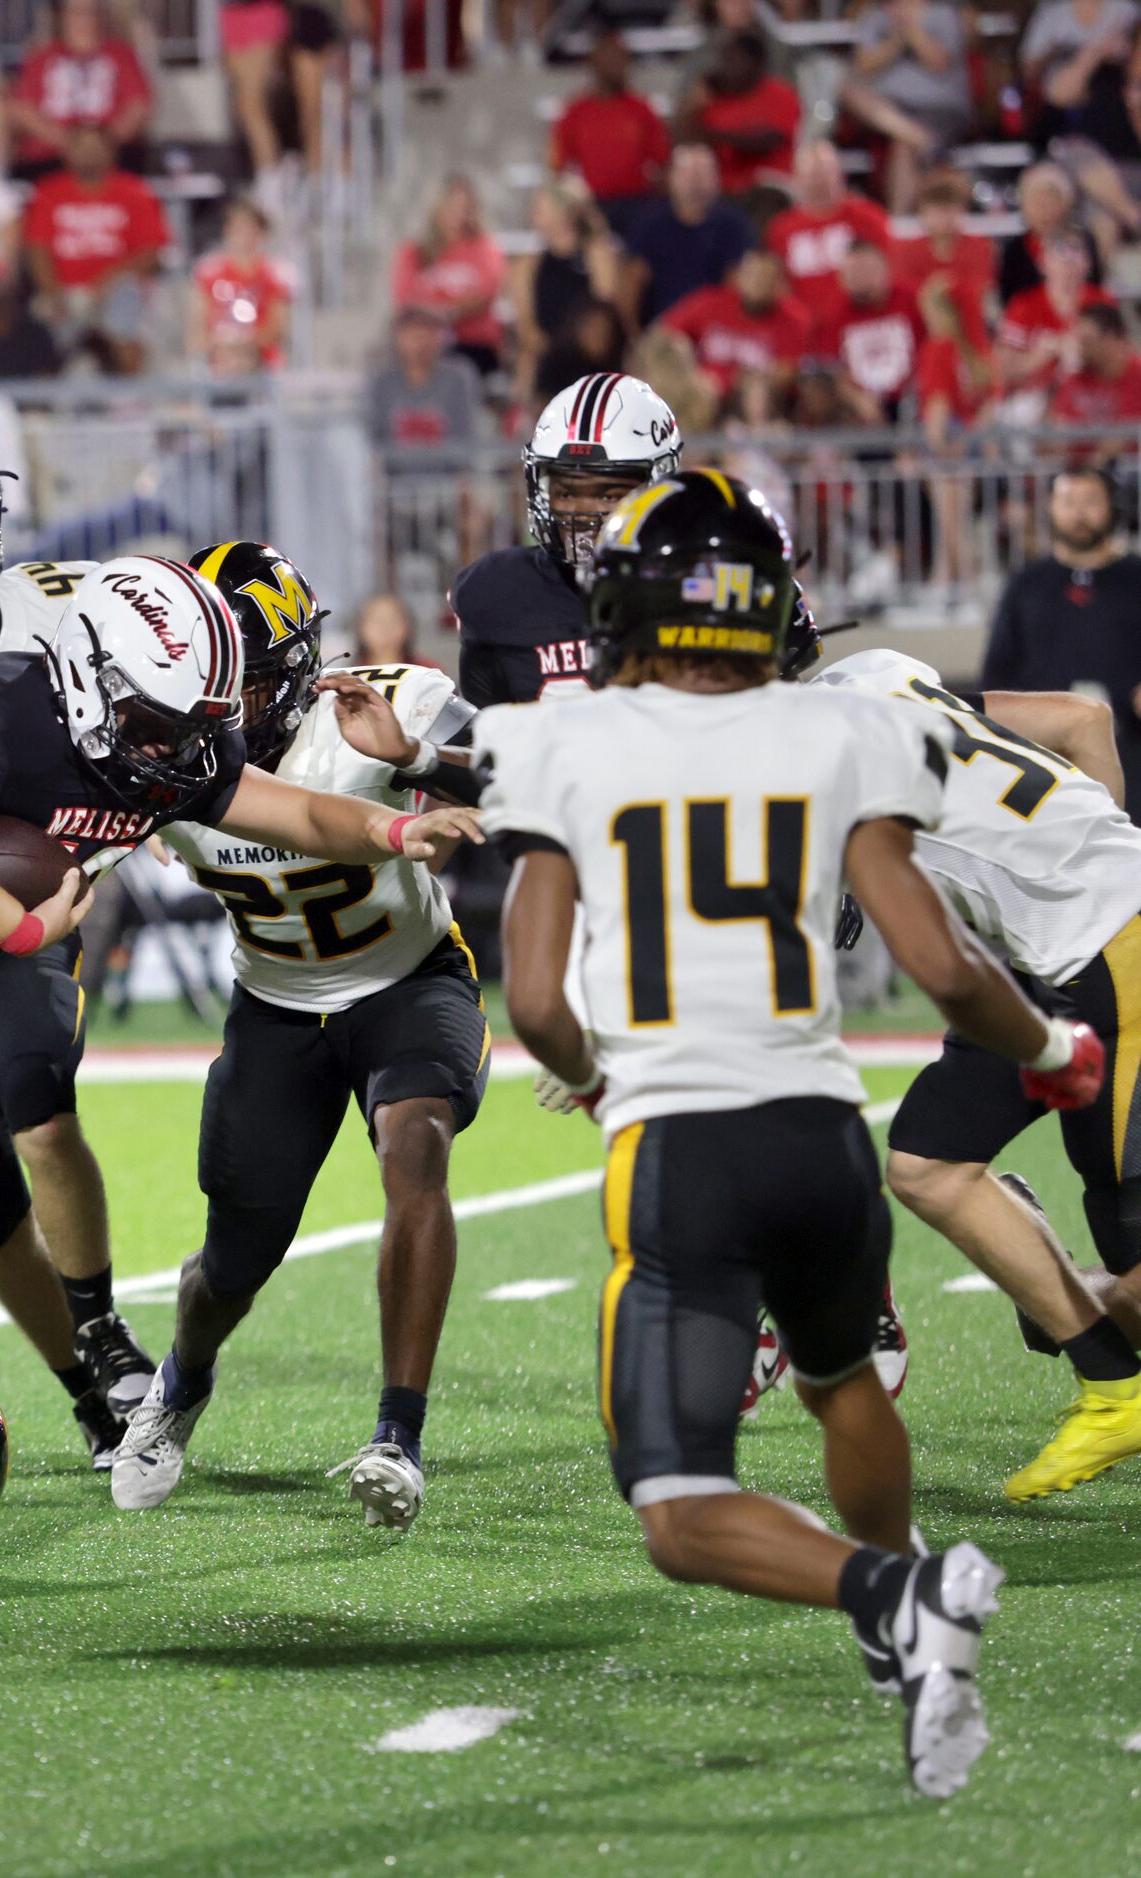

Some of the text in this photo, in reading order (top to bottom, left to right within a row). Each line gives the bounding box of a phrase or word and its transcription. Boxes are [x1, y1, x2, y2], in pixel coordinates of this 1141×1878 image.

[111, 573, 190, 662] Cardinals
[233, 560, 315, 650] M
[712, 562, 754, 612] 14
[45, 807, 156, 841] MELISSA
[193, 860, 397, 963] 22
[607, 794, 817, 1028] 14
